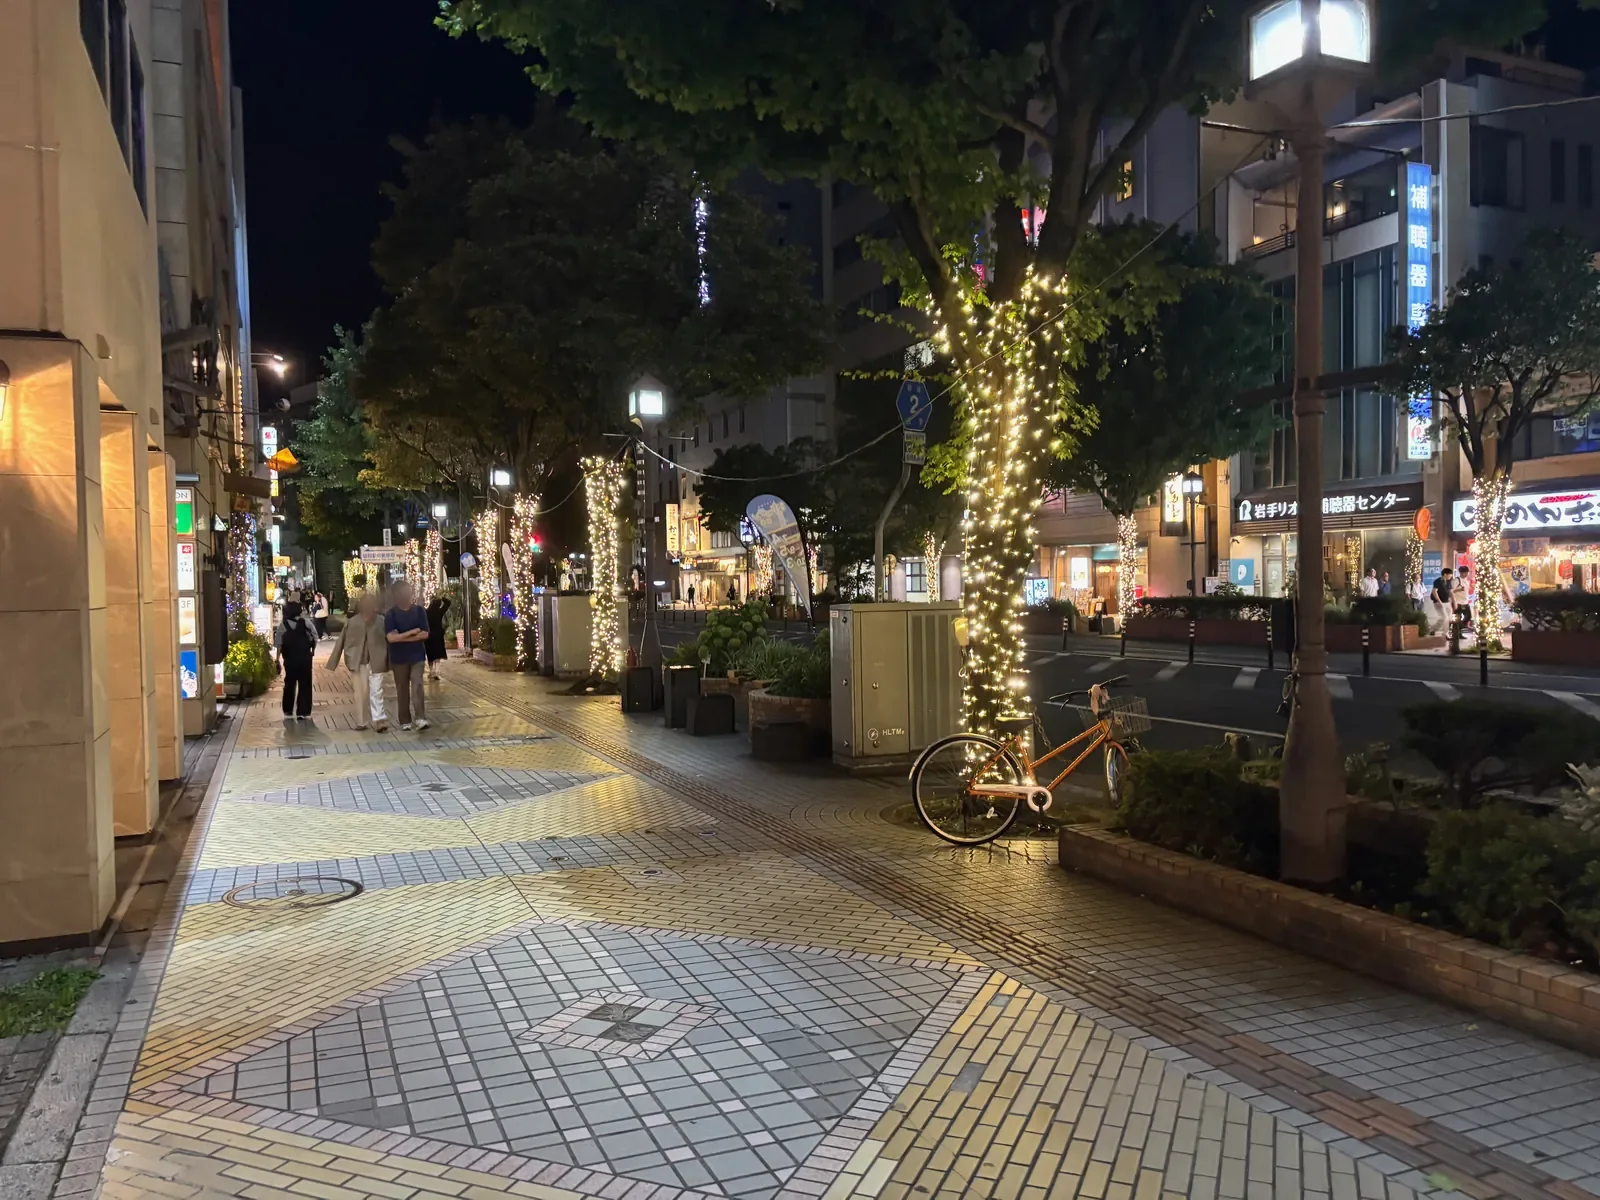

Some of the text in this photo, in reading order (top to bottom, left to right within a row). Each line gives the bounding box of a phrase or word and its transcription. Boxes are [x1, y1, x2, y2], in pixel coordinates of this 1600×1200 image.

[1410, 183, 1428, 330] 補聴器専
[909, 394, 919, 414] 2
[1254, 501, 1298, 519] 岩手リオ
[180, 600, 191, 608] 3F
